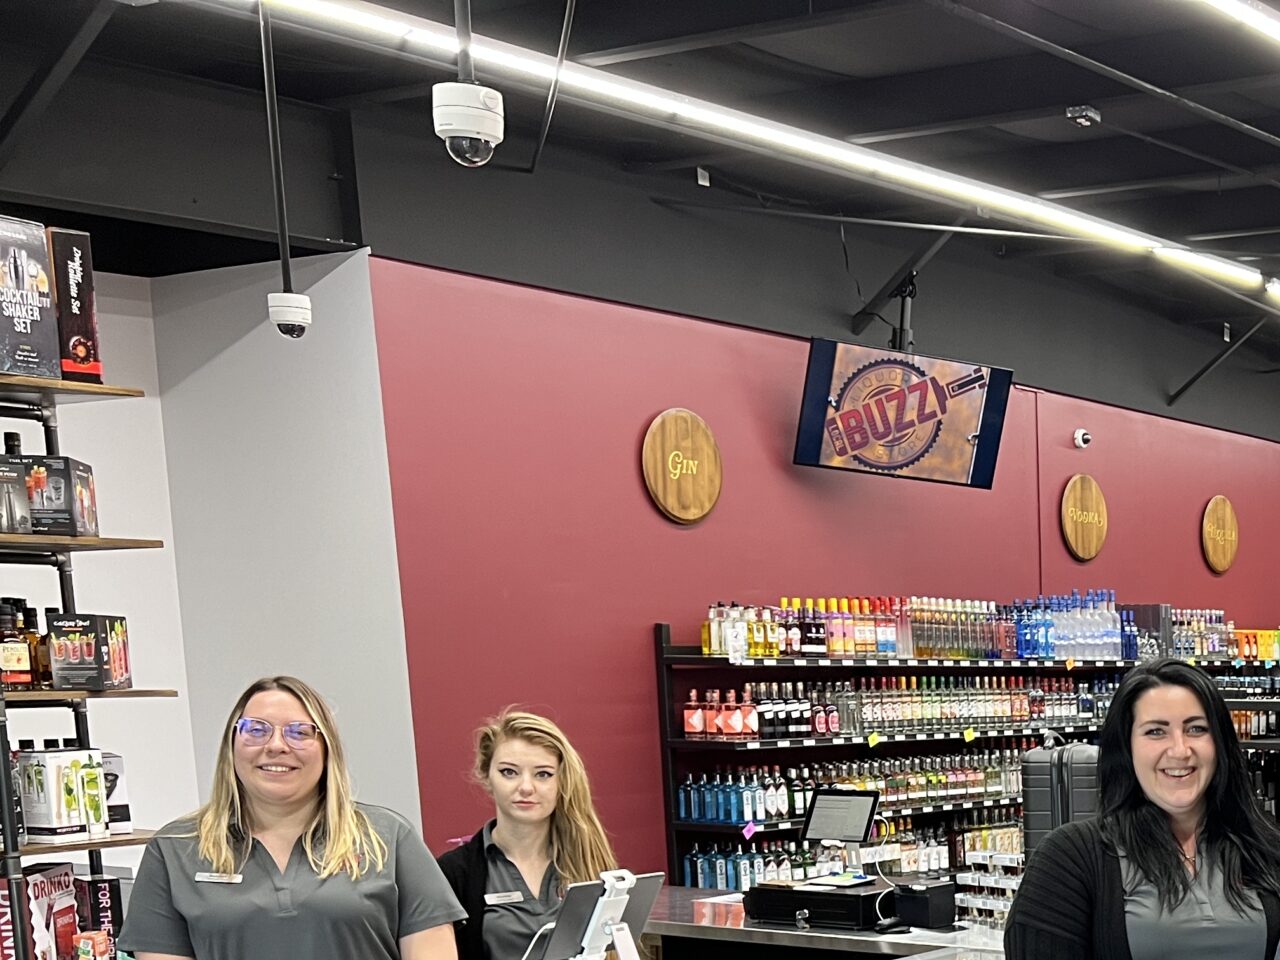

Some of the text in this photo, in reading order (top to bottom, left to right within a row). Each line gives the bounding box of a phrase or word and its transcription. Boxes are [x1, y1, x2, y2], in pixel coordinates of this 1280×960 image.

[2, 301, 40, 321] SHAKER
[13, 316, 32, 334] SET
[839, 376, 938, 453] BUZZ
[829, 423, 844, 452] LOCAL
[32, 871, 71, 901] DRINKO
[97, 882, 111, 908] FOR
[99, 910, 113, 934] THE
